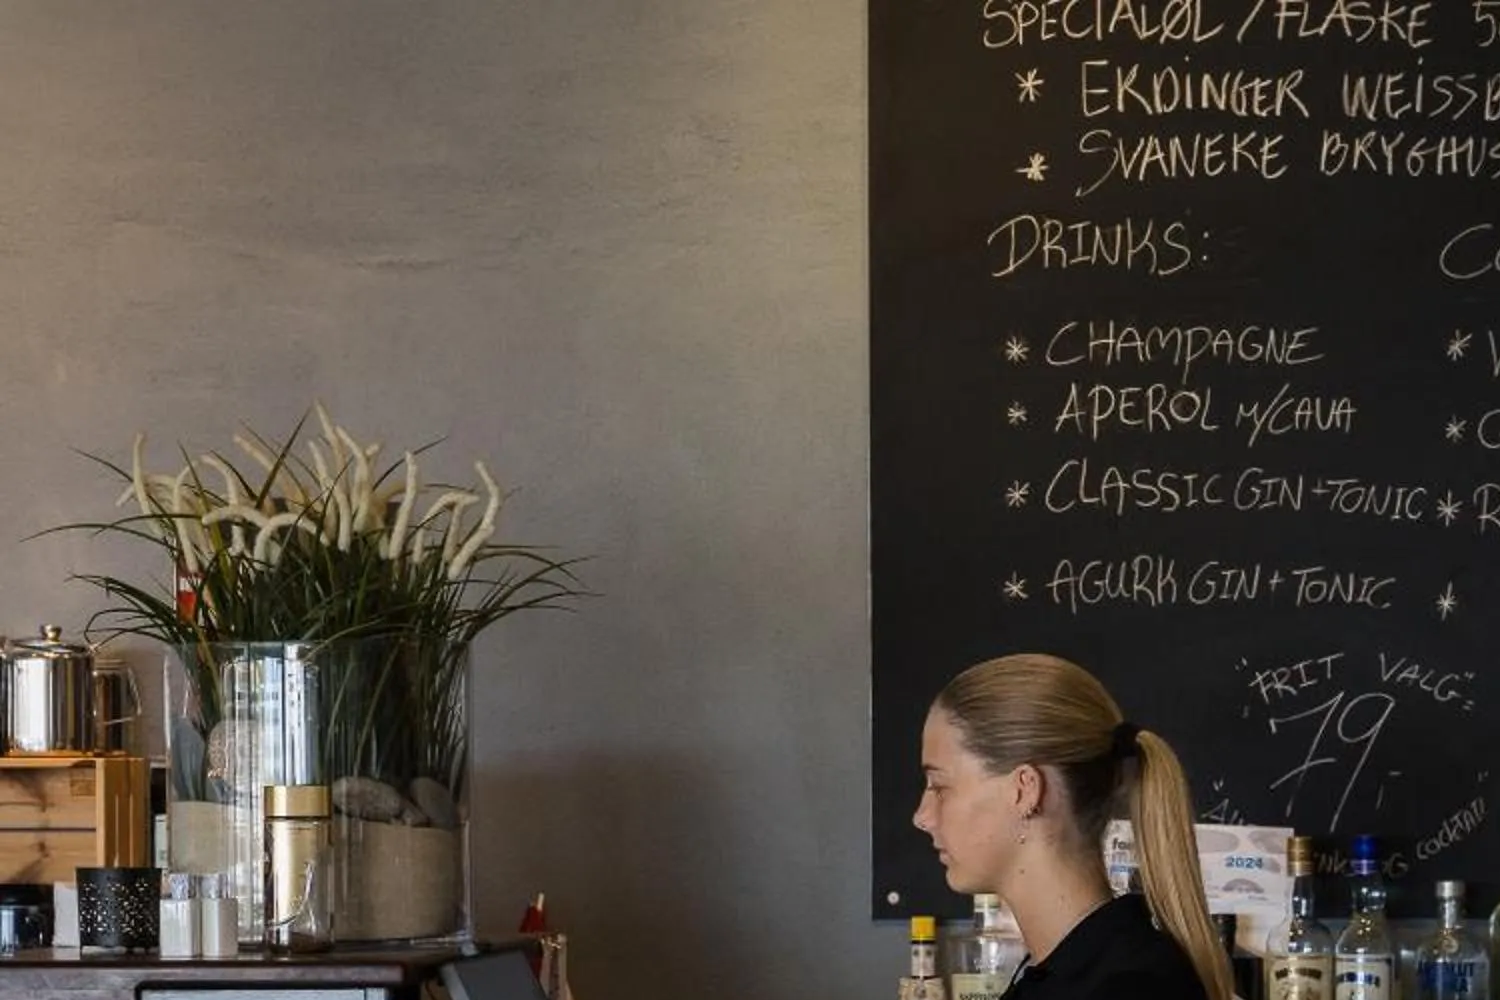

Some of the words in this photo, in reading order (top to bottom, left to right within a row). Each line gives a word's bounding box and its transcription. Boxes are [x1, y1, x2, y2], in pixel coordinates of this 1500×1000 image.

[1274, 0, 1432, 47] FLASKE
[1076, 129, 1288, 196] SVANEKE
[987, 214, 1210, 277] DRINKS:
[1045, 320, 1324, 384] CHAMPAGNE
[1055, 382, 1219, 441] APEROL
[1045, 458, 1223, 515] CLASSIC
[1046, 555, 1178, 614] AGURK
[1188, 561, 1261, 604] GIN
[1292, 566, 1396, 609] TONIC
[1225, 856, 1264, 869] 2024
